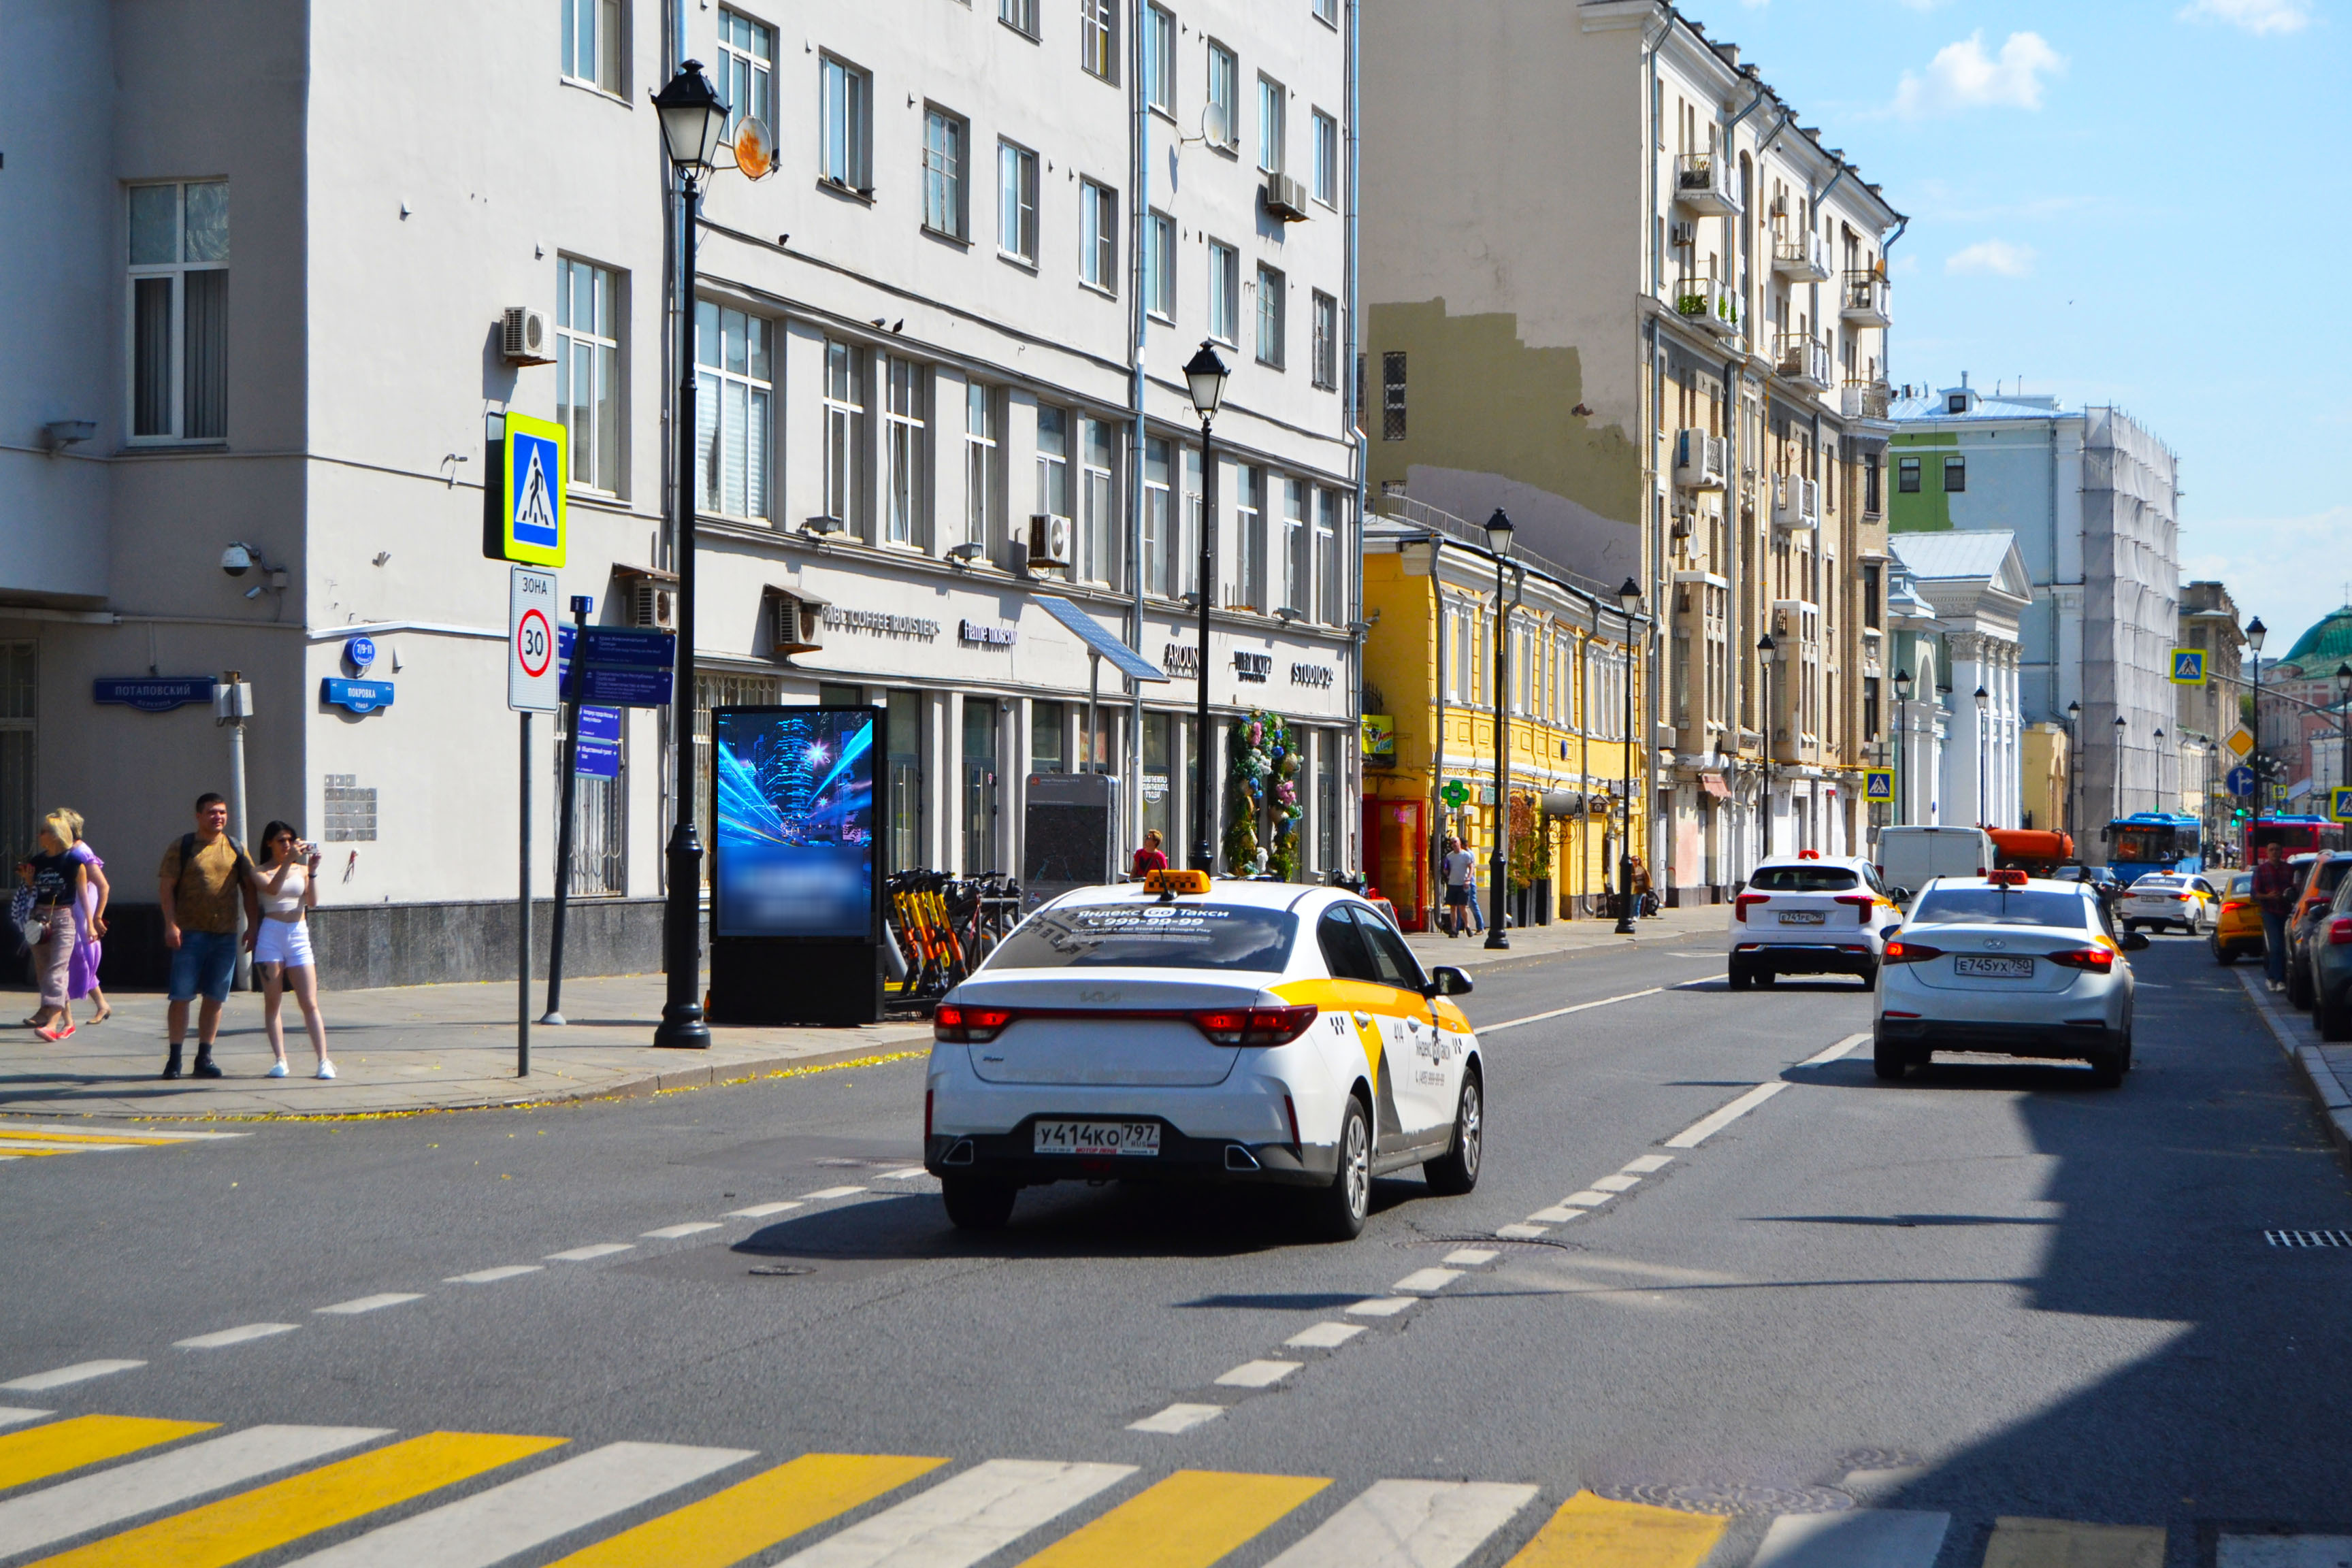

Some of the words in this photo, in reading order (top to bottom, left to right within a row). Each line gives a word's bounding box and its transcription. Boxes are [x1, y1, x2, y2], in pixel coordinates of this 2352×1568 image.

[523, 577, 547, 595] ЗОНА
[827, 606, 847, 624] ABC
[852, 610, 889, 630] COFFEE
[894, 615, 941, 636] ROASTERS
[525, 629, 543, 656] 30
[1167, 643, 1199, 668] AROUN
[1234, 651, 1252, 672] WHY
[1253, 653, 1272, 675] NOT?
[1294, 662, 1324, 685] STUDIO
[115, 683, 191, 696] ПОТАПОВСКИЙ
[348, 687, 376, 699] ПОКРОВКА
[1077, 910, 1141, 918] Яндекс
[1180, 908, 1229, 917] Такси
[1104, 917, 1204, 926] 999-99-99
[1960, 958, 2008, 972] Е745УХ
[2010, 959, 2029, 970] 750
[1041, 1123, 1120, 1146] У414КО
[1124, 1124, 1155, 1141] 797
